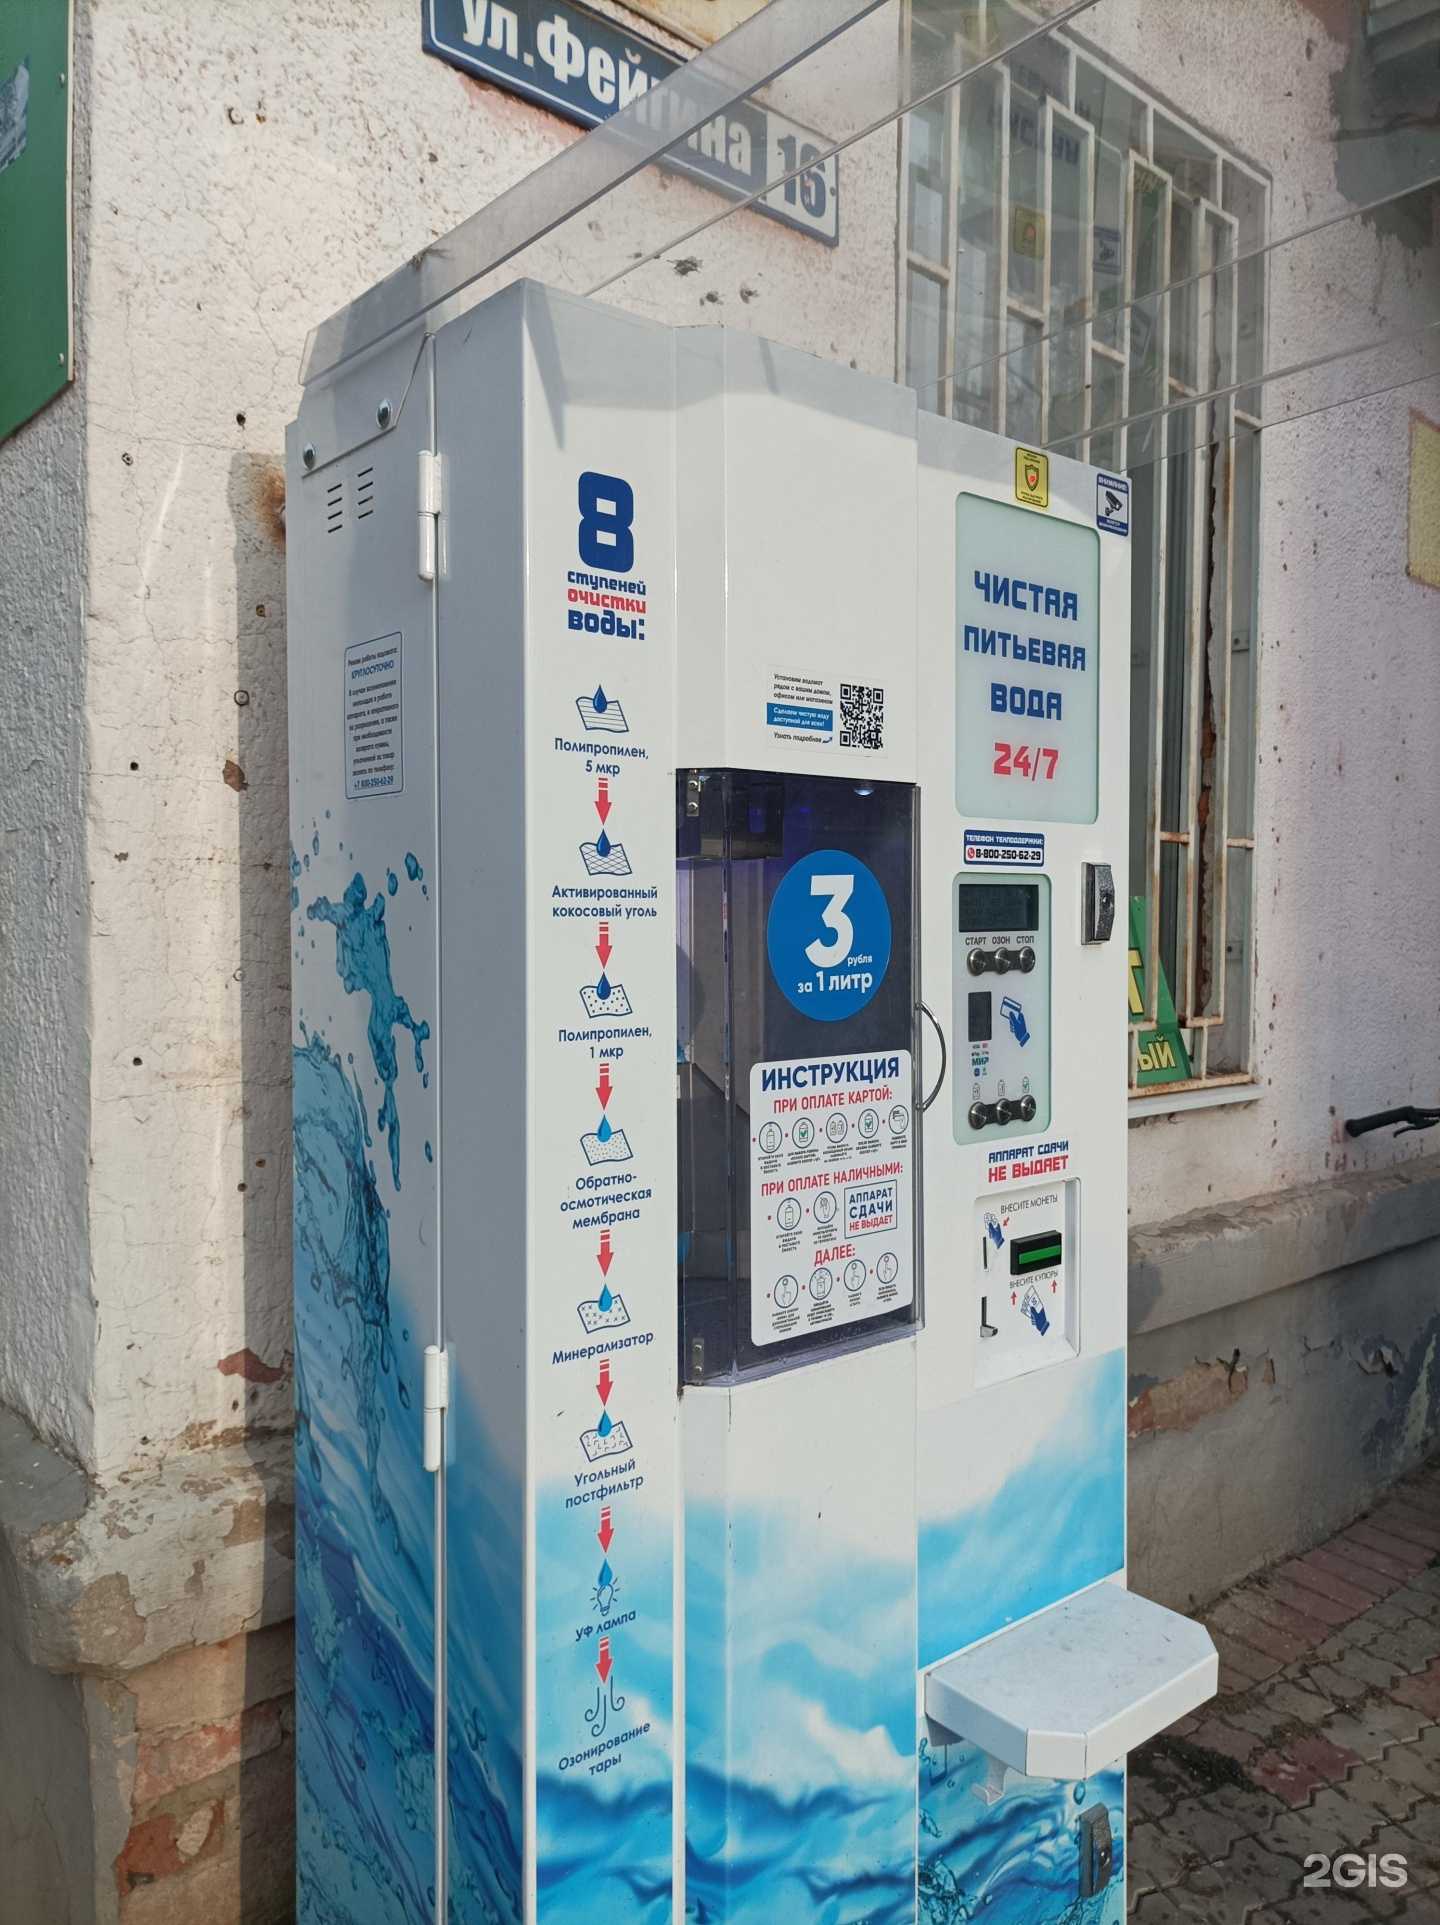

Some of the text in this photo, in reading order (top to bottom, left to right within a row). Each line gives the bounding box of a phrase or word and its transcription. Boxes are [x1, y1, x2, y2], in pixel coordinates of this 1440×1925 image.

[776, 133, 827, 218] 16
[578, 471, 634, 573] 8
[567, 571, 646, 595] ступеней
[567, 588, 646, 614] очистки
[974, 570, 1078, 621] ЧИСТАЯ
[567, 609, 645, 640] воды:
[963, 624, 1086, 671] ПИТЬЕВАЯ
[990, 682, 1062, 721] ВОДА
[774, 732, 792, 740] Узнать
[554, 738, 649, 760] Полипропилен,
[585, 760, 621, 777] 5 мкр
[993, 742, 1059, 782] 24/7
[966, 834, 995, 843] ТЕЛЕФОН
[975, 848, 1041, 860] 8-800-250-62-29
[551, 885, 658, 903] Активированный
[552, 904, 658, 920] кокосовый уголь
[805, 874, 855, 968] 3
[965, 935, 1035, 946] СТАРТ ОЗОН СТОП
[847, 954, 873, 967] рубля
[797, 971, 873, 994] за 1 литр
[558, 1026, 652, 1042] Полипропилен,
[589, 1045, 624, 1060] 1 мкр
[761, 1056, 900, 1092] ИНСТРУКЦИЯ
[773, 1084, 893, 1114] ПРИ ОПЛАТЕ КАРТОЙ:
[988, 1140, 1069, 1164] АППАРАТ СДАЧИ
[575, 1171, 637, 1191] Обратно-
[761, 1161, 904, 1197] ПРИ ОПЛАТЕ НАЛИЧНЫМИ:
[988, 1155, 1069, 1183] НЕ ВЫДАЕТ
[560, 1188, 652, 1212] осмотическая
[849, 1187, 893, 1205] АППАРАТ
[1000, 1194, 1058, 1215] ВНЕСИТЕ МОНЕТЫ
[572, 1208, 640, 1230] мембрана
[849, 1201, 893, 1220] СДАЧИ
[849, 1214, 893, 1232] НЕ ВЫДАЕТ
[814, 1243, 856, 1267] ДАЛЕЕ:
[551, 1332, 654, 1365] Минерализатор
[574, 1458, 636, 1487] Угольный
[565, 1475, 644, 1509] постфильтр
[595, 1610, 637, 1634] лампа
[558, 1722, 651, 1771] Озонирование
[588, 1753, 622, 1776] тары
